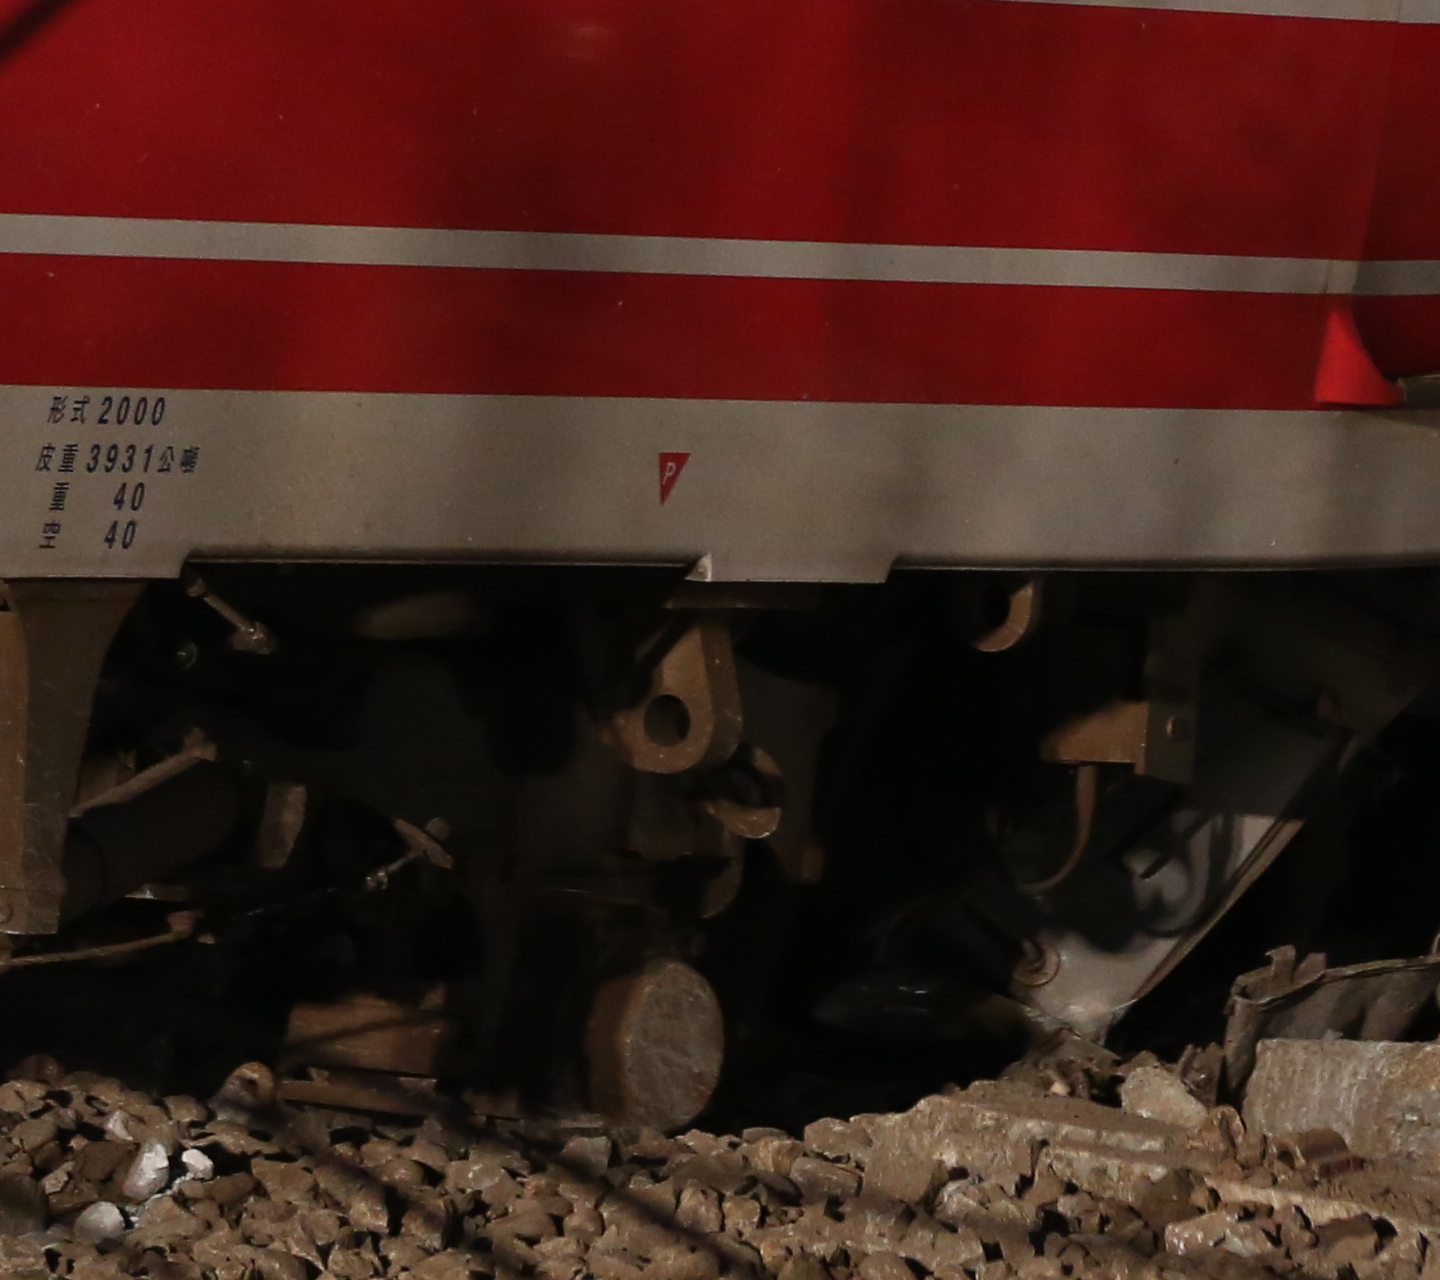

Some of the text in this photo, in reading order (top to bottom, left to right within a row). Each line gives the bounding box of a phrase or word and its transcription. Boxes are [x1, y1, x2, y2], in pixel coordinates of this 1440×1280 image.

[47, 395, 166, 426] 形式 2000
[661, 461, 677, 485] P
[113, 481, 146, 511] 40
[103, 519, 138, 549] 40
